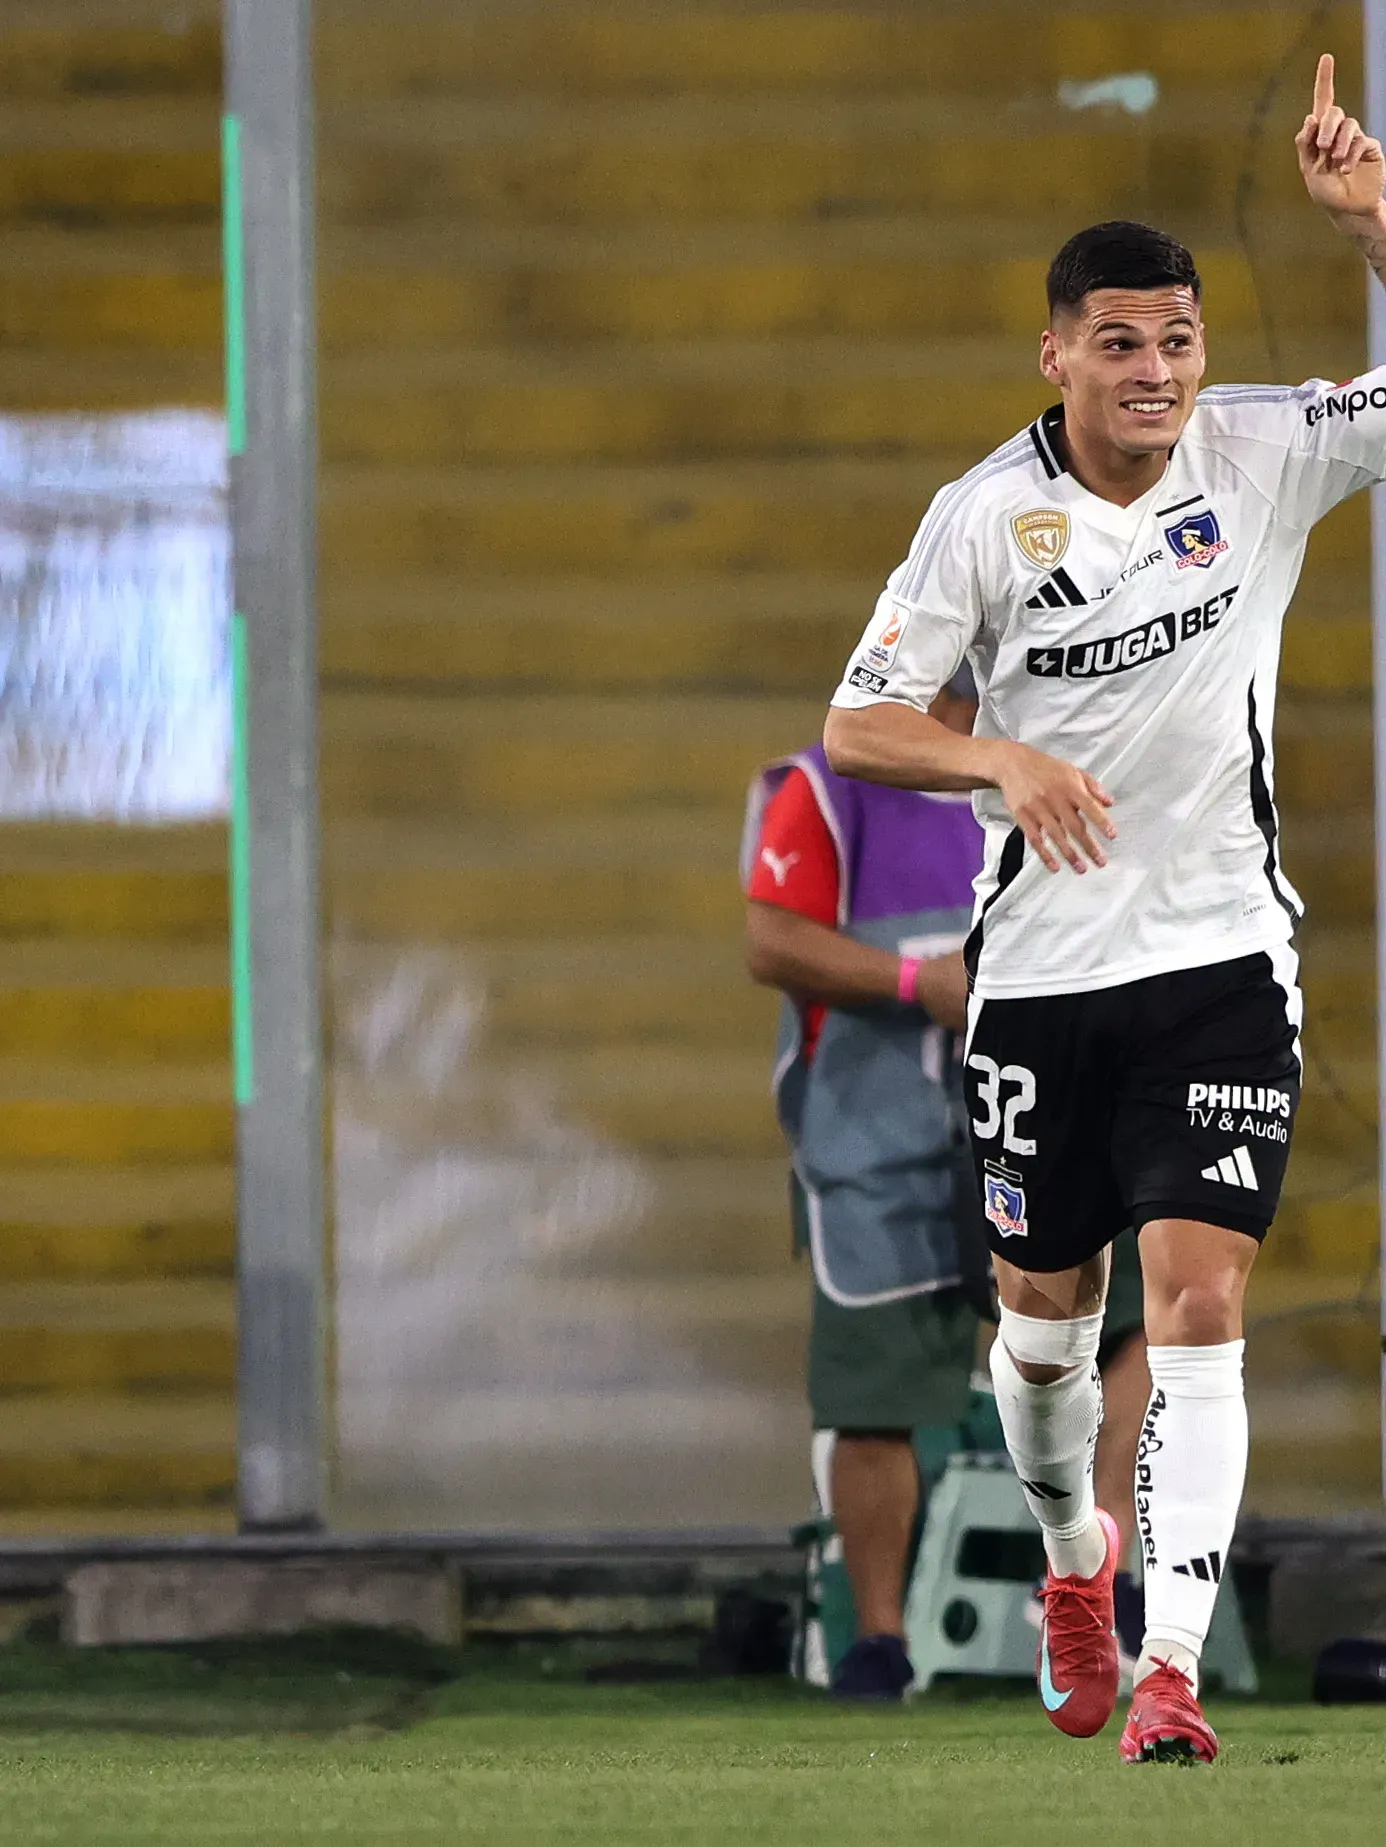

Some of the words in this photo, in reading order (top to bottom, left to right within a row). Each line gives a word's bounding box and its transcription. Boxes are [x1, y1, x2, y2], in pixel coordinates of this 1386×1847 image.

[968, 1054, 1037, 1156] 32
[1187, 1083, 1290, 1118] PHILIPS
[1186, 1107, 1214, 1128] TV
[1218, 1111, 1234, 1132] &
[1239, 1114, 1287, 1143] Audio
